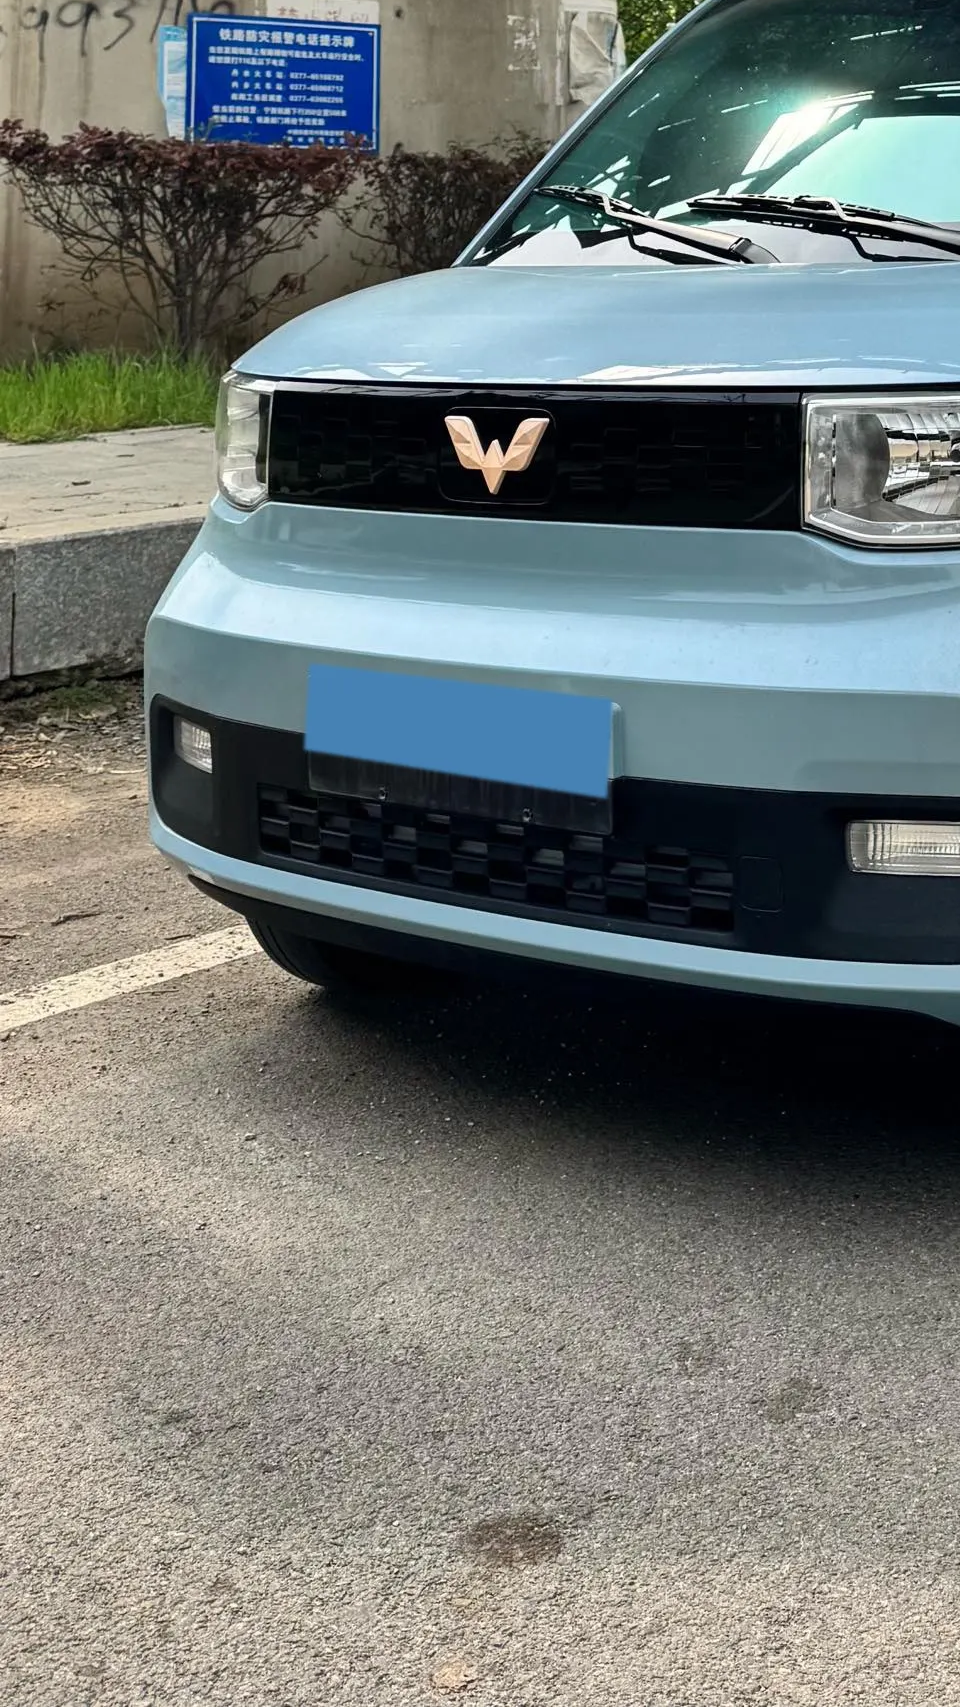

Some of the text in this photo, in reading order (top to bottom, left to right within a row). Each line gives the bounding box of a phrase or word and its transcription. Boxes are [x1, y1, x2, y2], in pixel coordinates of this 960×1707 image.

[219, 28, 354, 48] 铁路防灾报警电话提示牌
